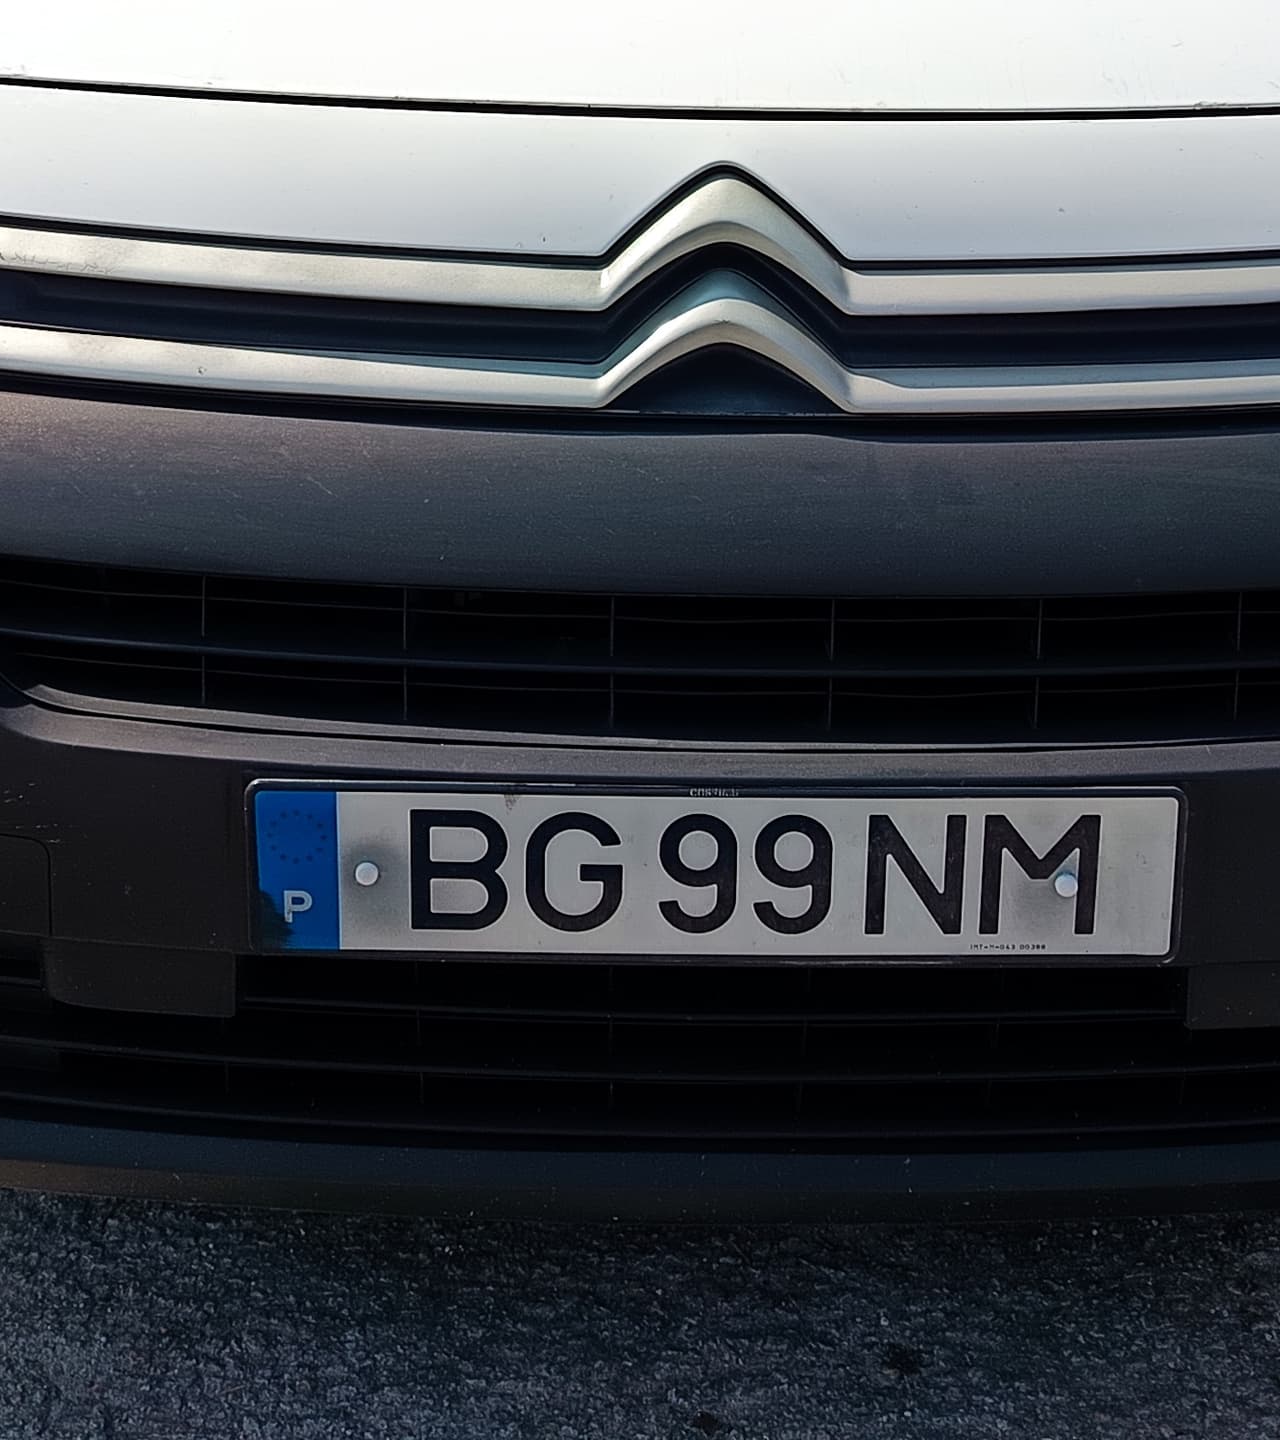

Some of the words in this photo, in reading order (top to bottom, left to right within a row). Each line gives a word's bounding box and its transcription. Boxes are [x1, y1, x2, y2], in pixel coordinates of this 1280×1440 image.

[283, 890, 313, 923] P
[409, 808, 622, 932] BG
[658, 813, 833, 935] 99
[863, 814, 1102, 935] NM
